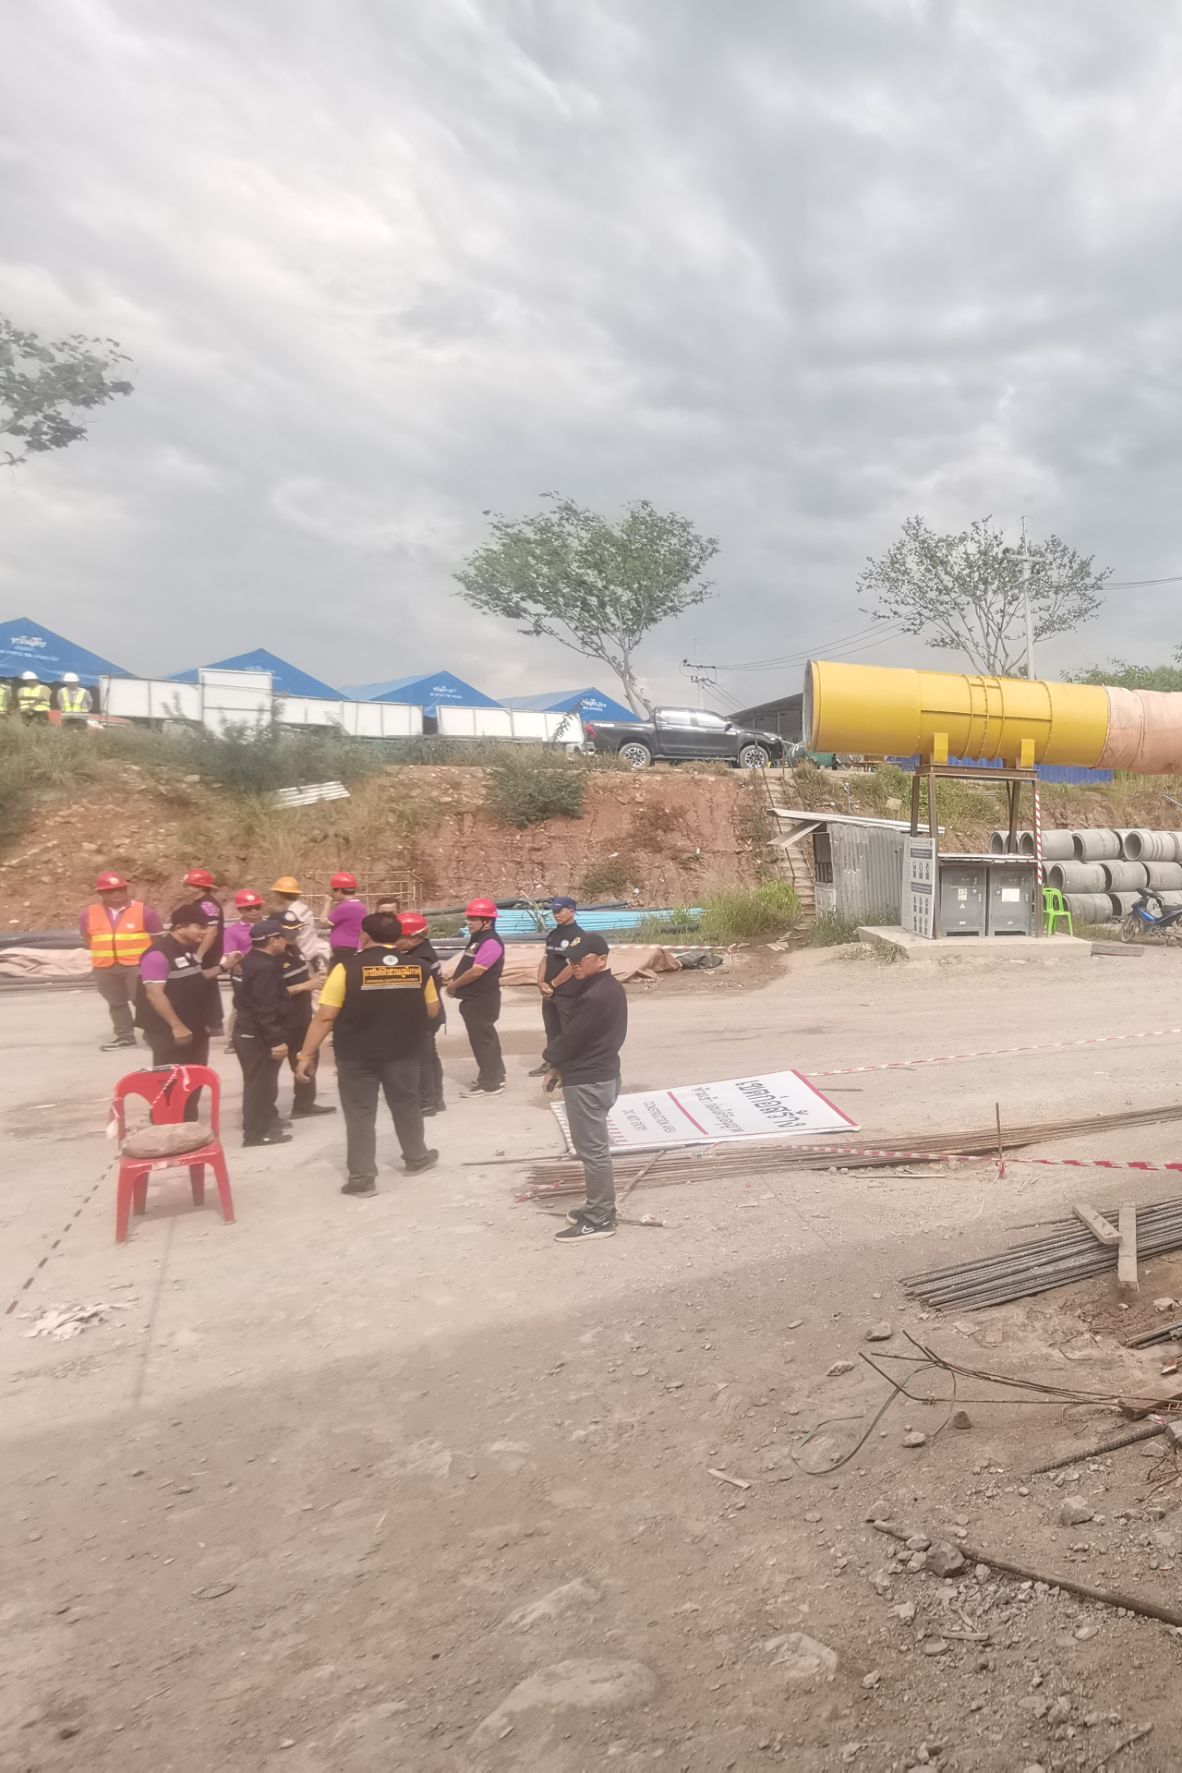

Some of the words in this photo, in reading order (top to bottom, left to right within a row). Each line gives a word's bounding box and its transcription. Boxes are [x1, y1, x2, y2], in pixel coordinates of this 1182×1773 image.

[735, 1079, 809, 1128] เขตก่อสร้าง
